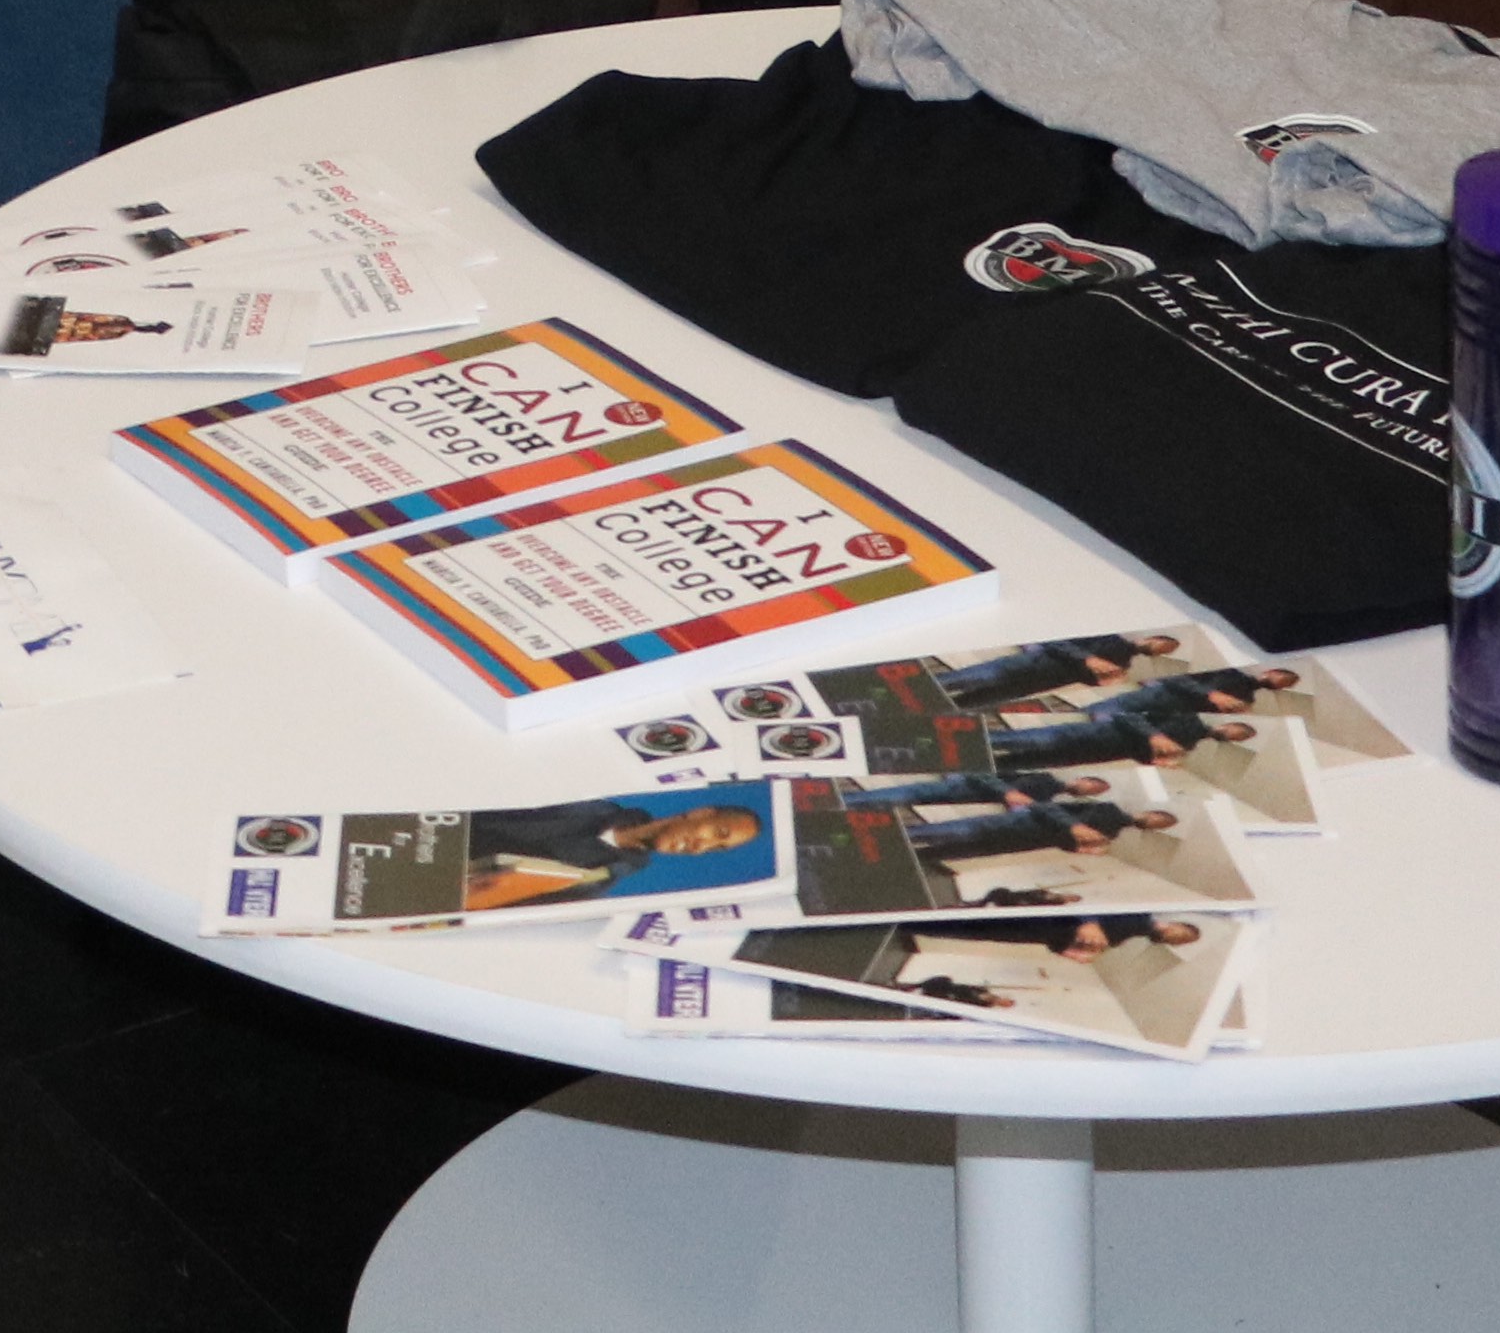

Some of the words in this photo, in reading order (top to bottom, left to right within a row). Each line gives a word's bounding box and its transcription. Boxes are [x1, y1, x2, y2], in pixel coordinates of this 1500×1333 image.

[354, 253, 373, 269] FOR
[373, 251, 414, 296] BROTHERS
[363, 269, 401, 313] EXCELLENCE
[1137, 282, 1188, 320] THE
[461, 361, 608, 444] CAN
[558, 380, 594, 395] I
[1289, 341, 1432, 416] CURA
[368, 429, 398, 446] THE
[369, 384, 500, 467] College
[412, 372, 556, 455] FINISH
[268, 413, 300, 429] AND
[291, 428, 322, 444] GET
[315, 440, 354, 463] YOUR
[342, 460, 398, 495] DEGREE
[284, 444, 331, 472] GUIDE
[346, 437, 374, 455] ANY
[367, 451, 424, 488] OBSTACLE
[691, 487, 849, 579] CAN
[796, 509, 833, 525] I
[594, 512, 735, 604] College
[641, 499, 794, 591] FINISH
[487, 541, 522, 559] AND
[512, 557, 546, 576] GET
[540, 575, 578, 599] YOUR
[567, 597, 626, 634] DEGREE
[504, 576, 552, 608] GUIDE
[571, 570, 599, 587] ANY
[593, 586, 654, 626] OBSTACLE
[594, 563, 625, 581] THE
[415, 812, 461, 864] Brothers
[343, 843, 393, 915] Excellence
